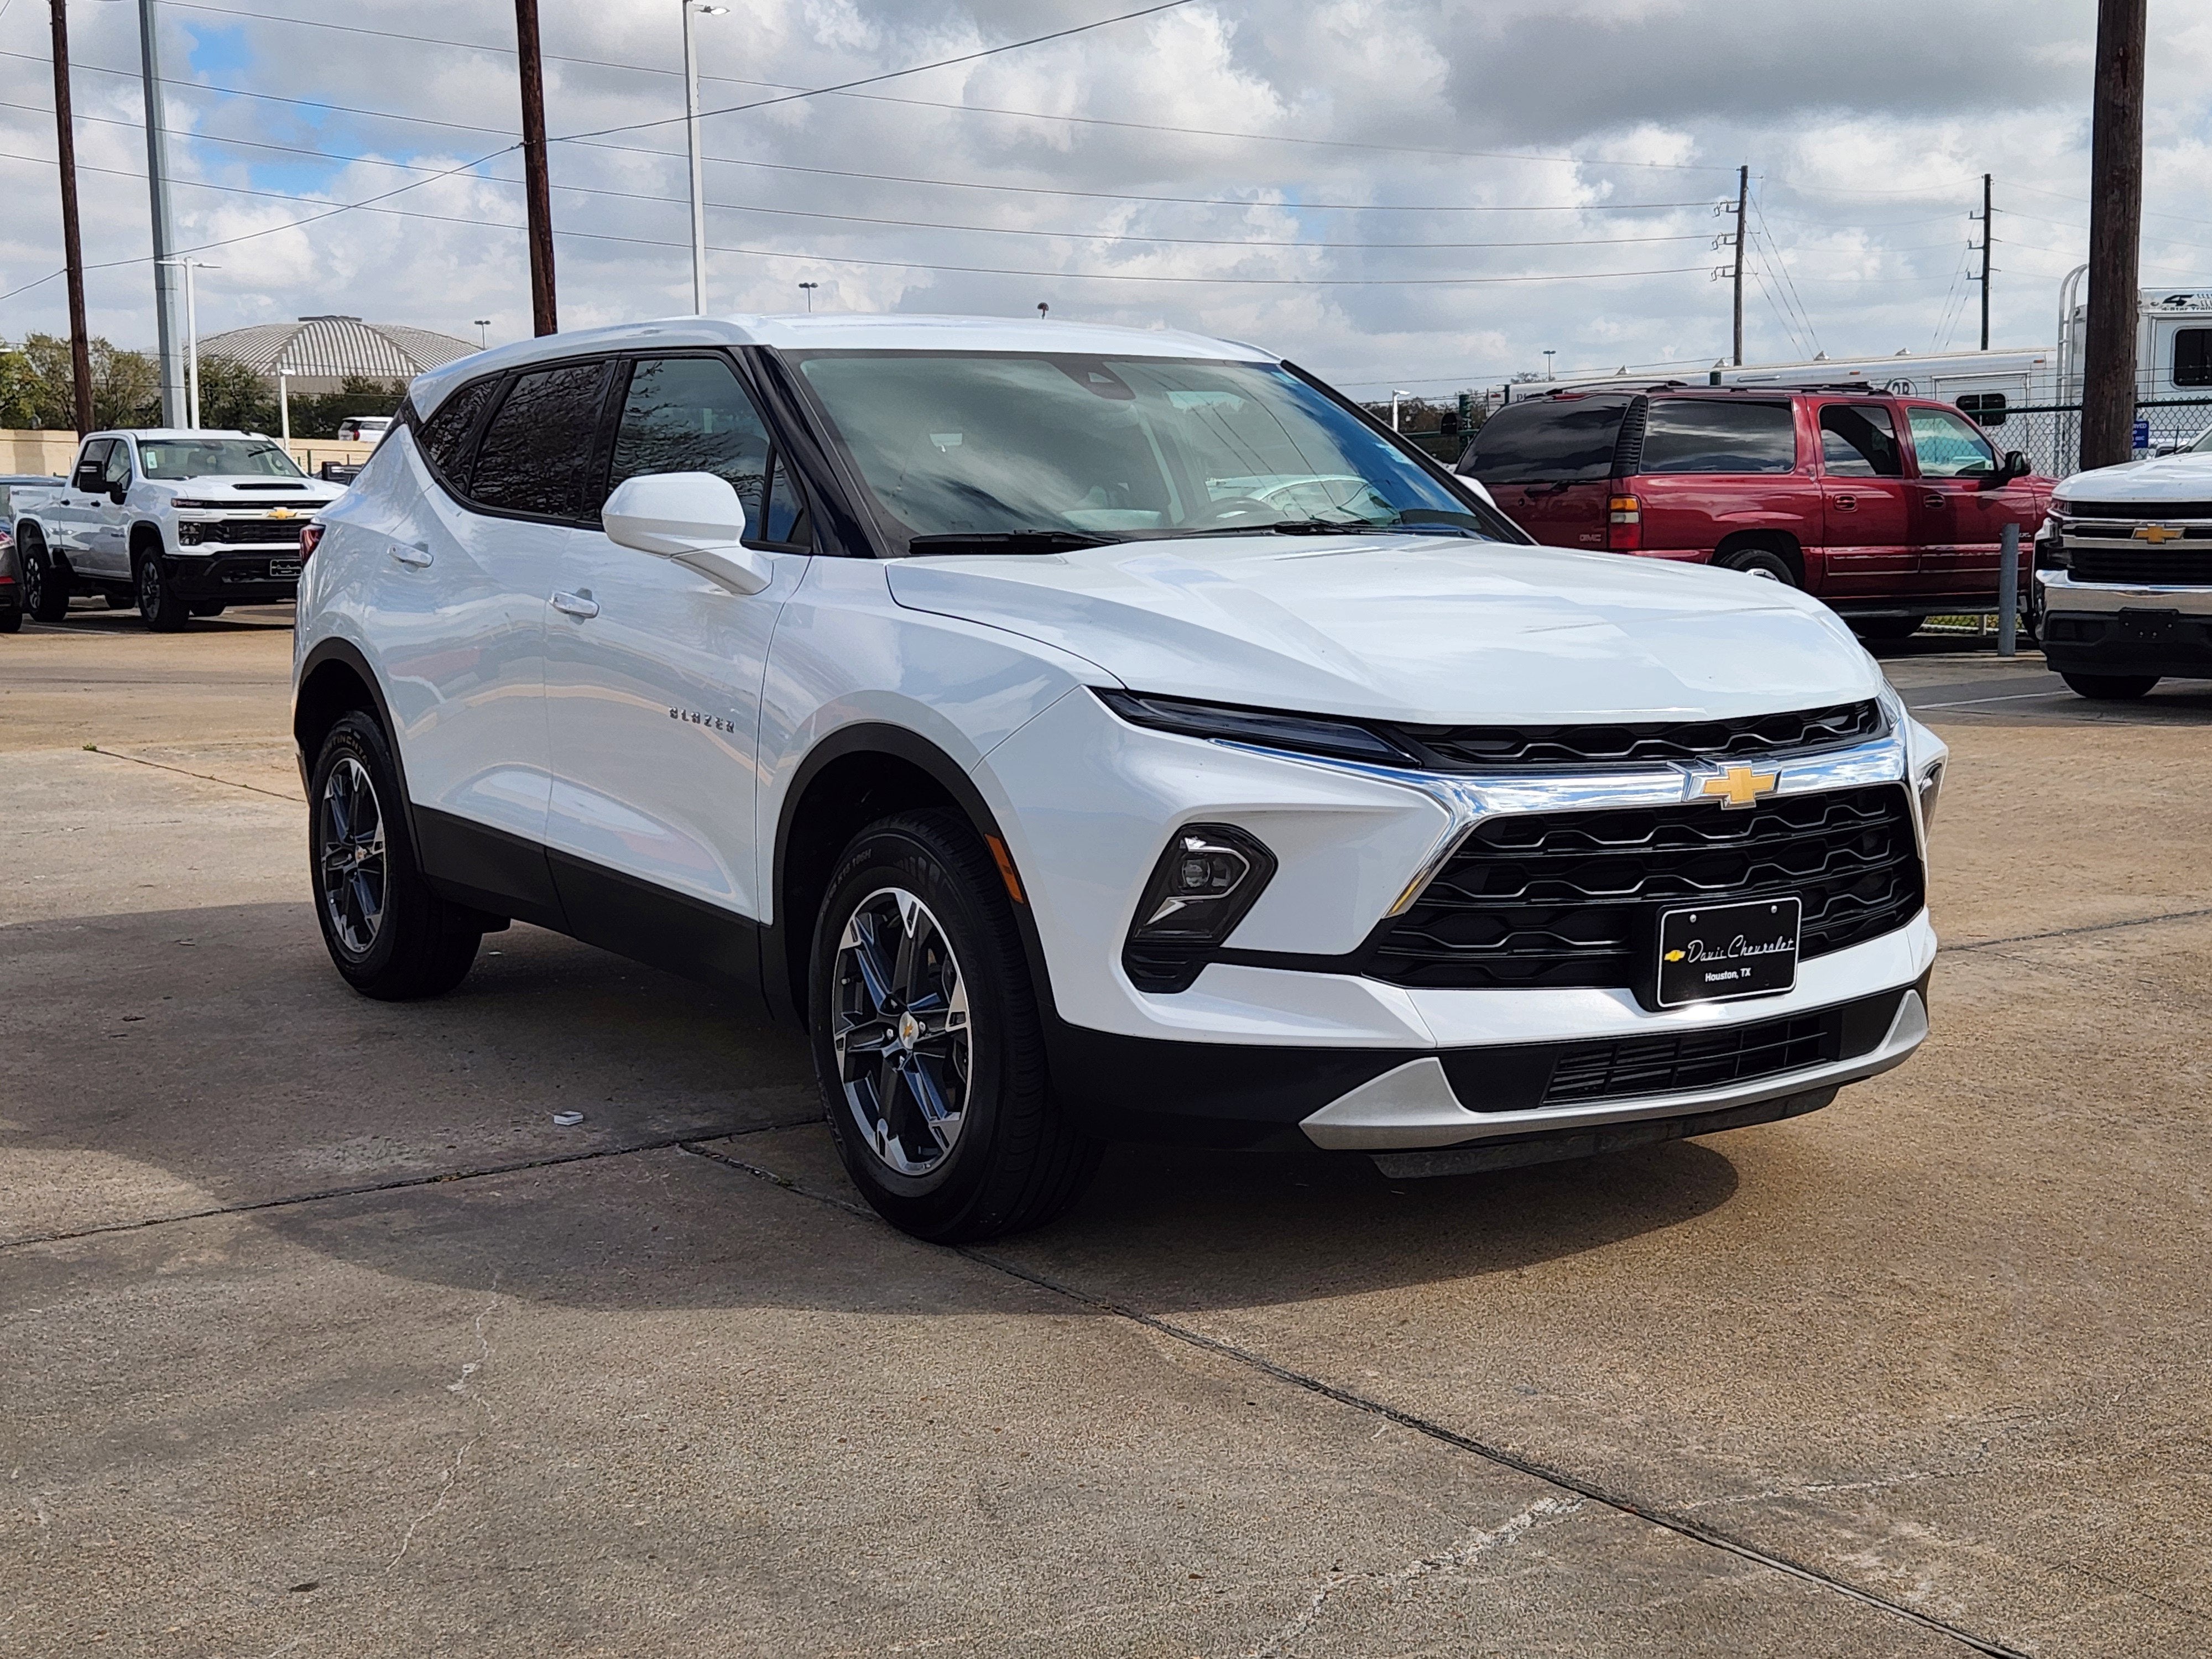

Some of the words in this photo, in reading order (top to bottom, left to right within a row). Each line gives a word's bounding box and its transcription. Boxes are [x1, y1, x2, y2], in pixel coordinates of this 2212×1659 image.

[669, 706, 735, 733] BLAZER
[1687, 940, 1728, 963] Davis
[1728, 935, 1795, 958] Chevrolet
[1705, 970, 1739, 983] Houston,
[1740, 967, 1752, 977] TX
